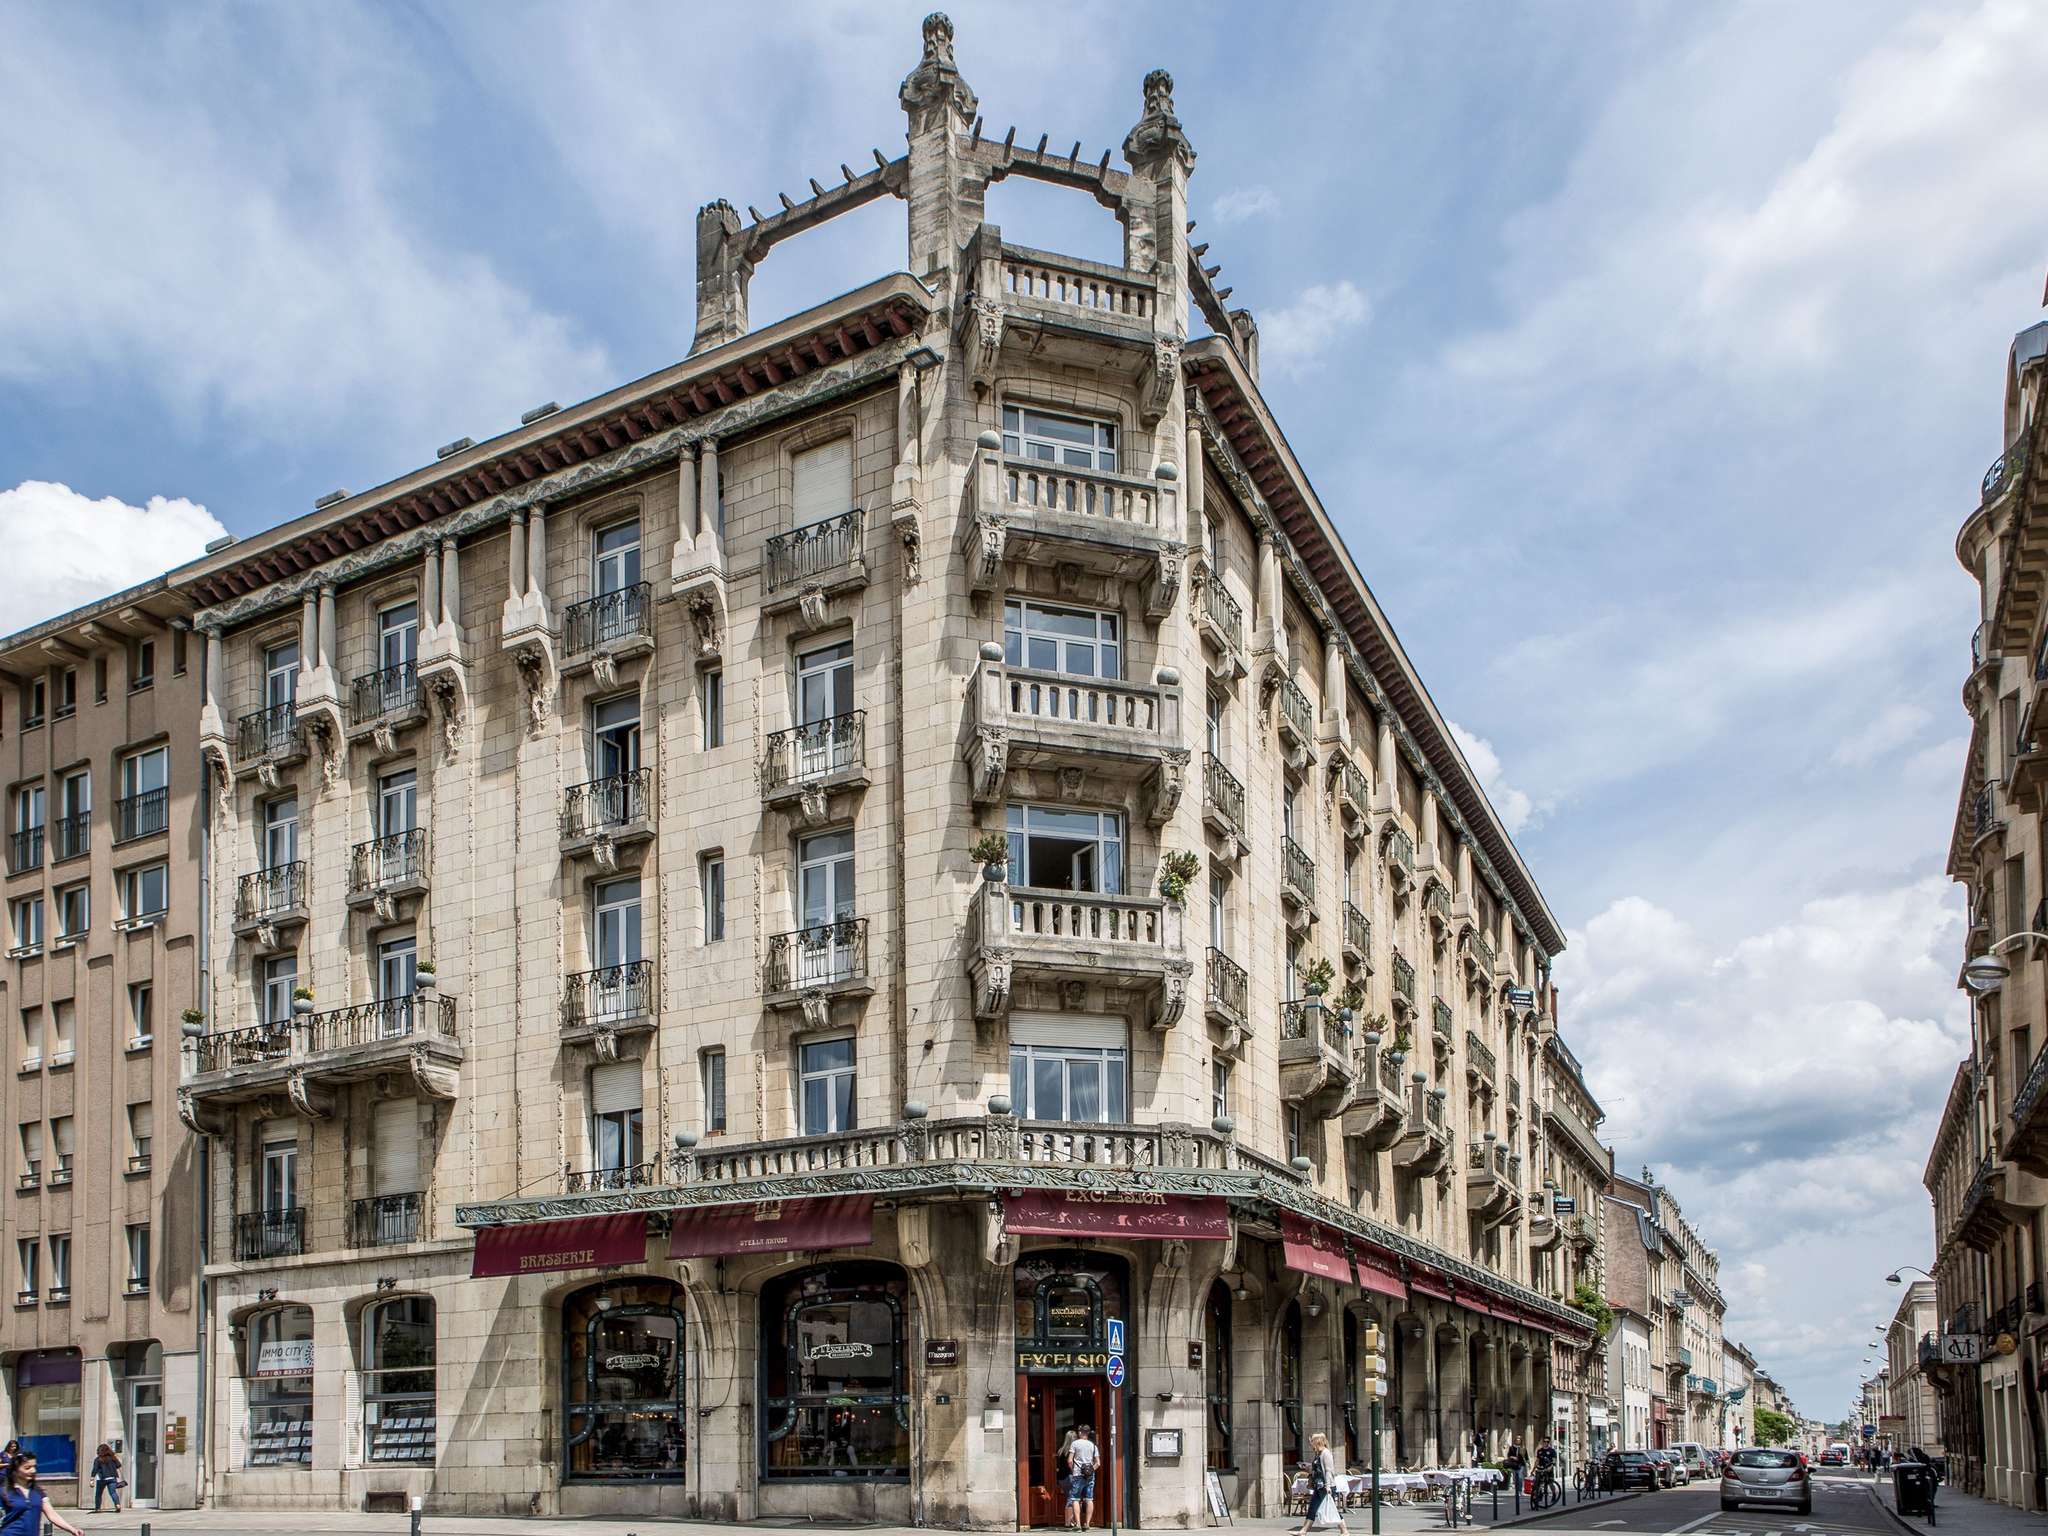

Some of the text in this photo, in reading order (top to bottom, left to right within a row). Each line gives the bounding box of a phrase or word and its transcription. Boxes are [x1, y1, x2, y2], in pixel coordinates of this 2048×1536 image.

[520, 1249, 594, 1269] BRASSERIE
[262, 1346, 304, 1358] IMMO CITY
[1019, 1353, 1109, 1368] EXCELSIO
